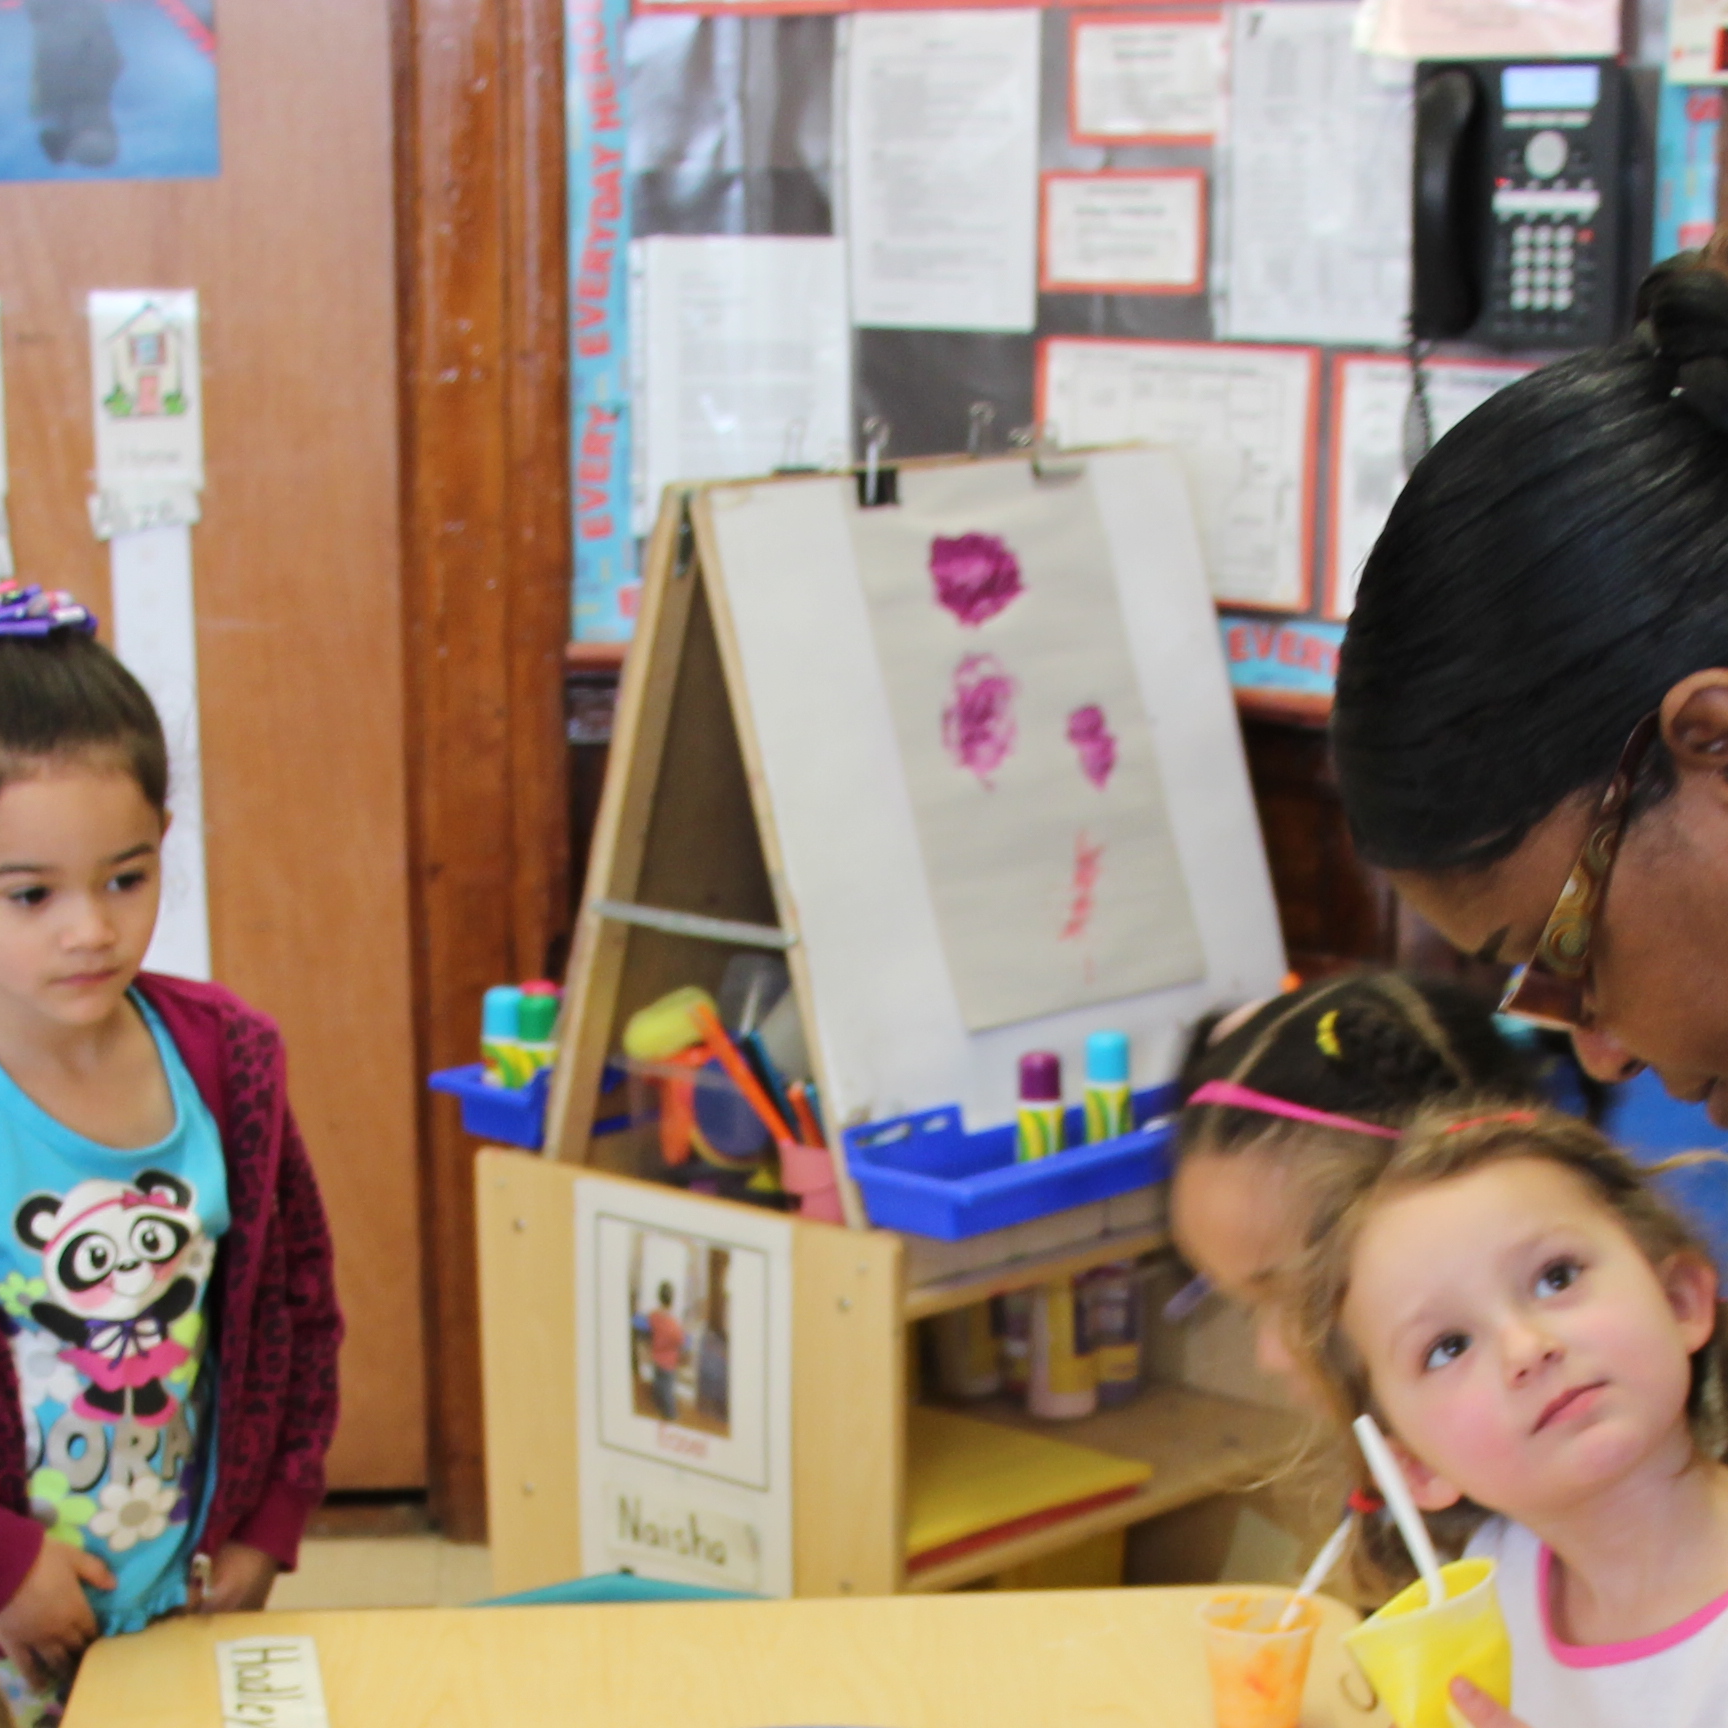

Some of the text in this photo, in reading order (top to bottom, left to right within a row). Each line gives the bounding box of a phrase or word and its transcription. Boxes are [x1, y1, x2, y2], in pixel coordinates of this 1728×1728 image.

[574, 143, 623, 358] EVERYDAY
[578, 404, 619, 541] EVERY
[618, 1496, 728, 1567] Naisha
